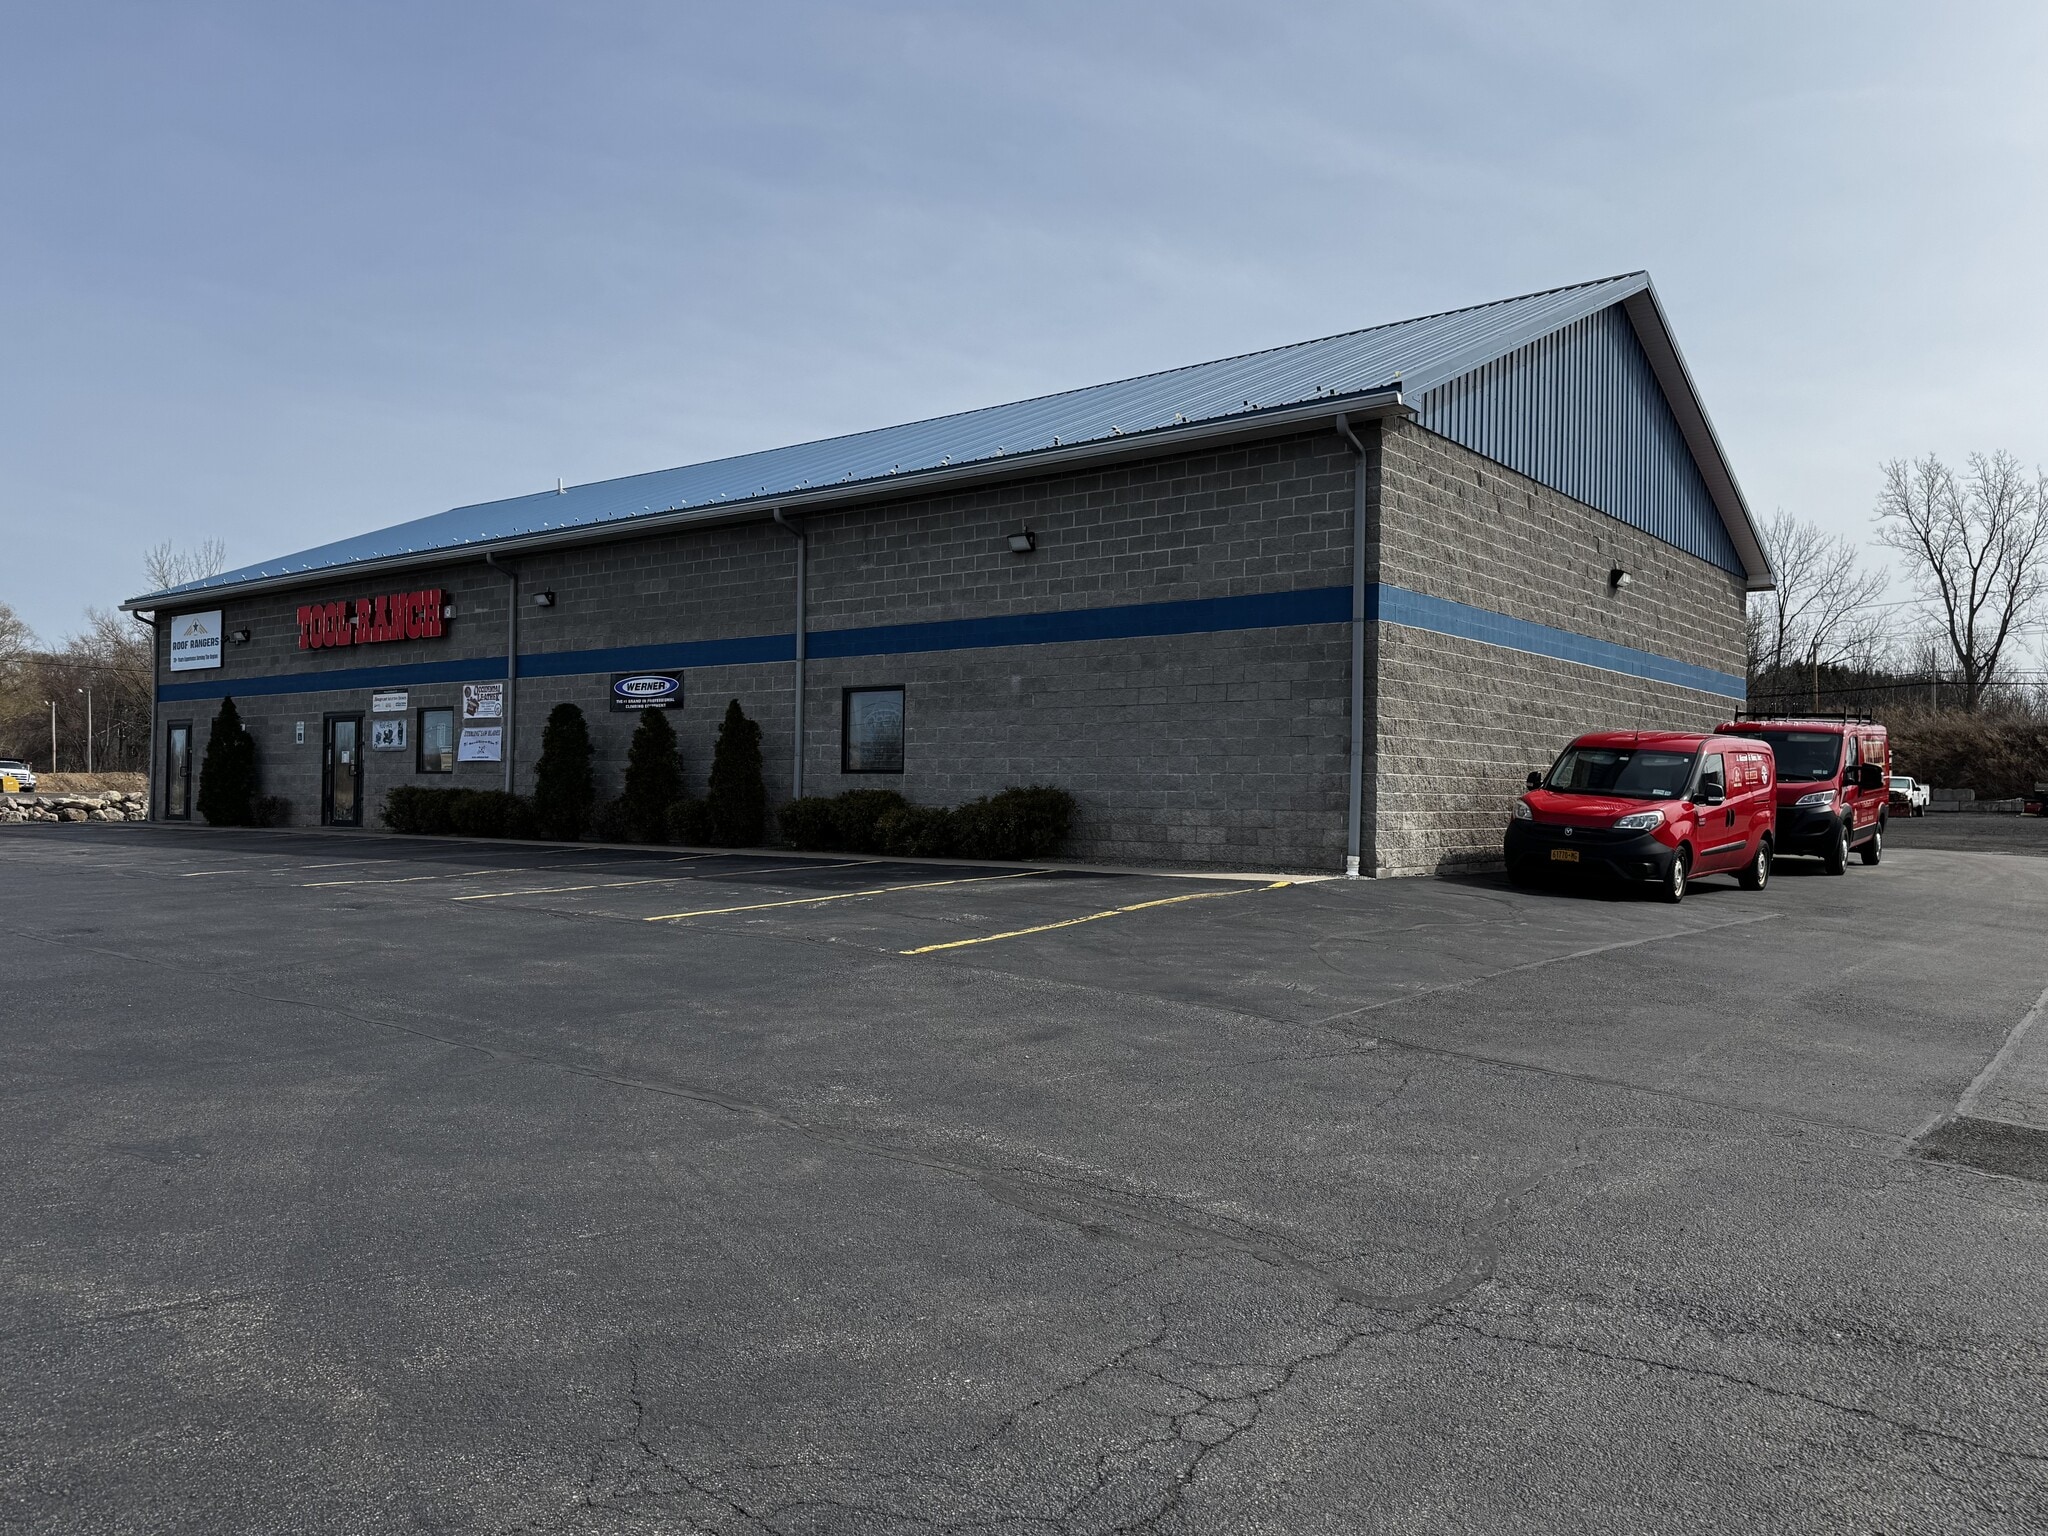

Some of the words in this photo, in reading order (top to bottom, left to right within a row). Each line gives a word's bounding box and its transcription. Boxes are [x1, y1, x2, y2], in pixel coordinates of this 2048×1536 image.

[297, 602, 351, 650] TOOL
[355, 588, 442, 644] RANCH
[172, 640, 189, 651] ROOF
[190, 637, 220, 649] RANGERS
[626, 681, 666, 691] WERNER
